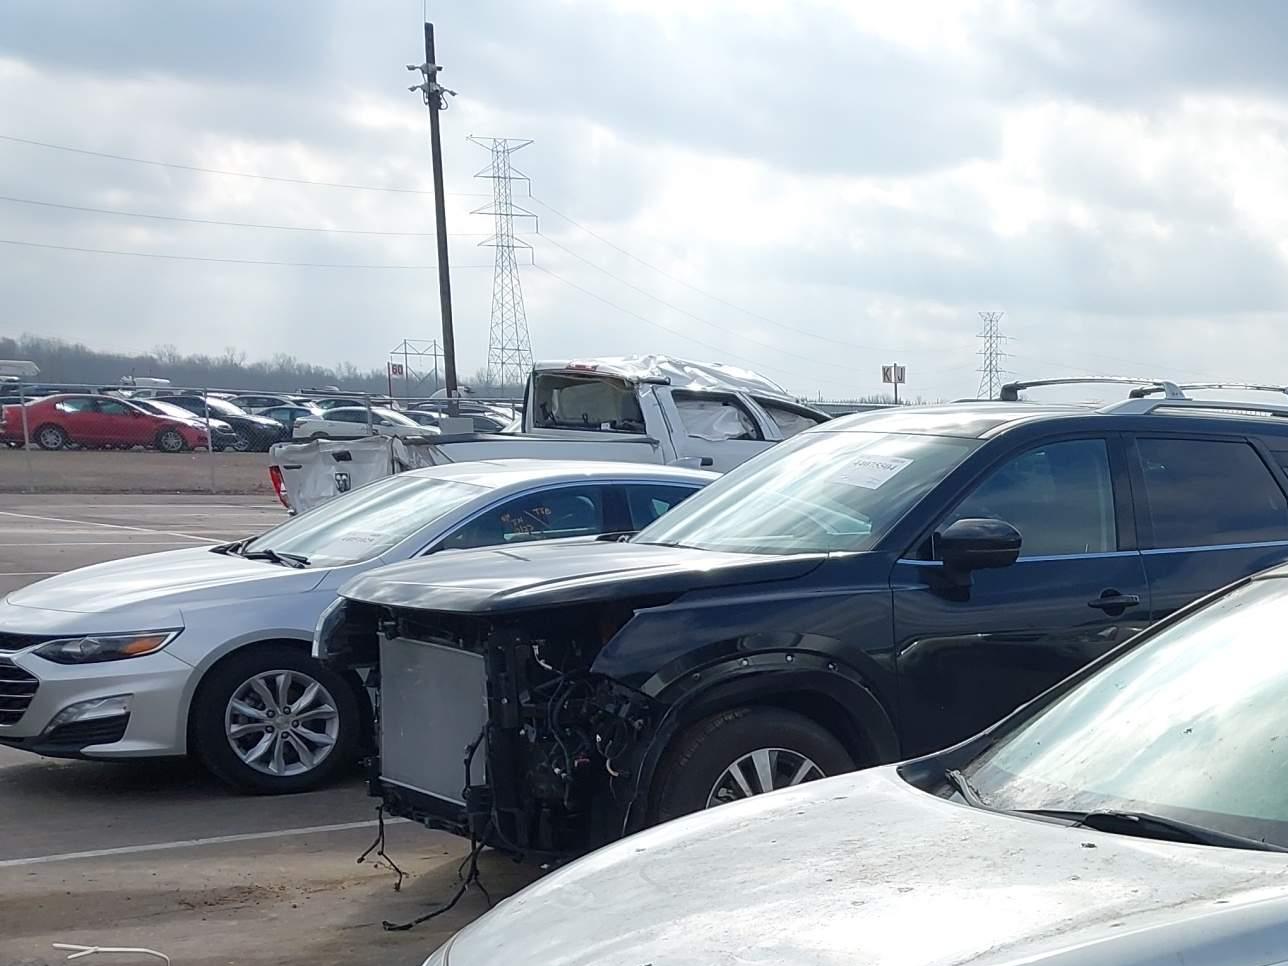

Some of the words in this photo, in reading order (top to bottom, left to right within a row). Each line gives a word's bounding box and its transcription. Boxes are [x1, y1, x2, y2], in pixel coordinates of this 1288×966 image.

[391, 364, 404, 375] 60
[883, 367, 891, 382] K
[897, 367, 903, 382] J
